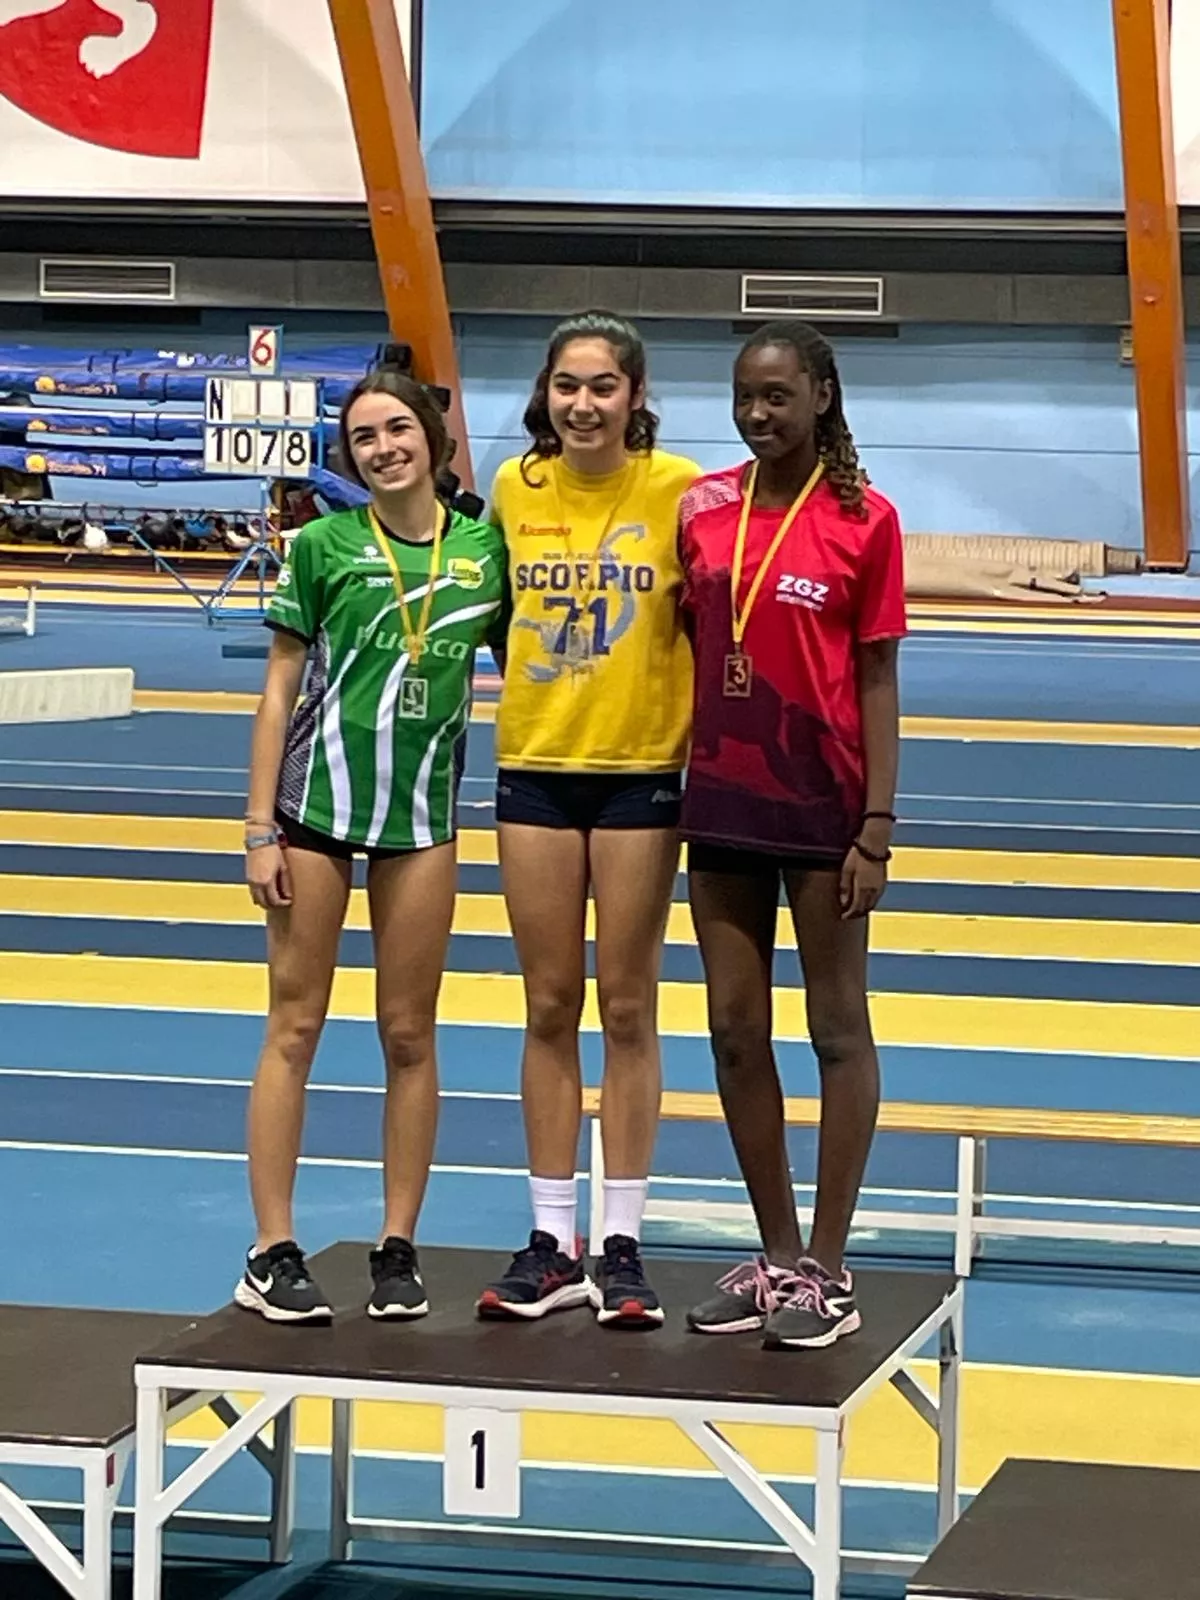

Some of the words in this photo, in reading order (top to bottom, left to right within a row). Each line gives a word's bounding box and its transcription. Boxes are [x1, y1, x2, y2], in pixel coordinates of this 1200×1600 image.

[251, 328, 273, 366] 6
[211, 427, 307, 466] 1078
[516, 563, 654, 592] SCORPIO
[776, 574, 829, 603] ZGZ
[543, 597, 610, 655] 71
[727, 659, 746, 685] 3
[471, 1430, 485, 1490] 1
